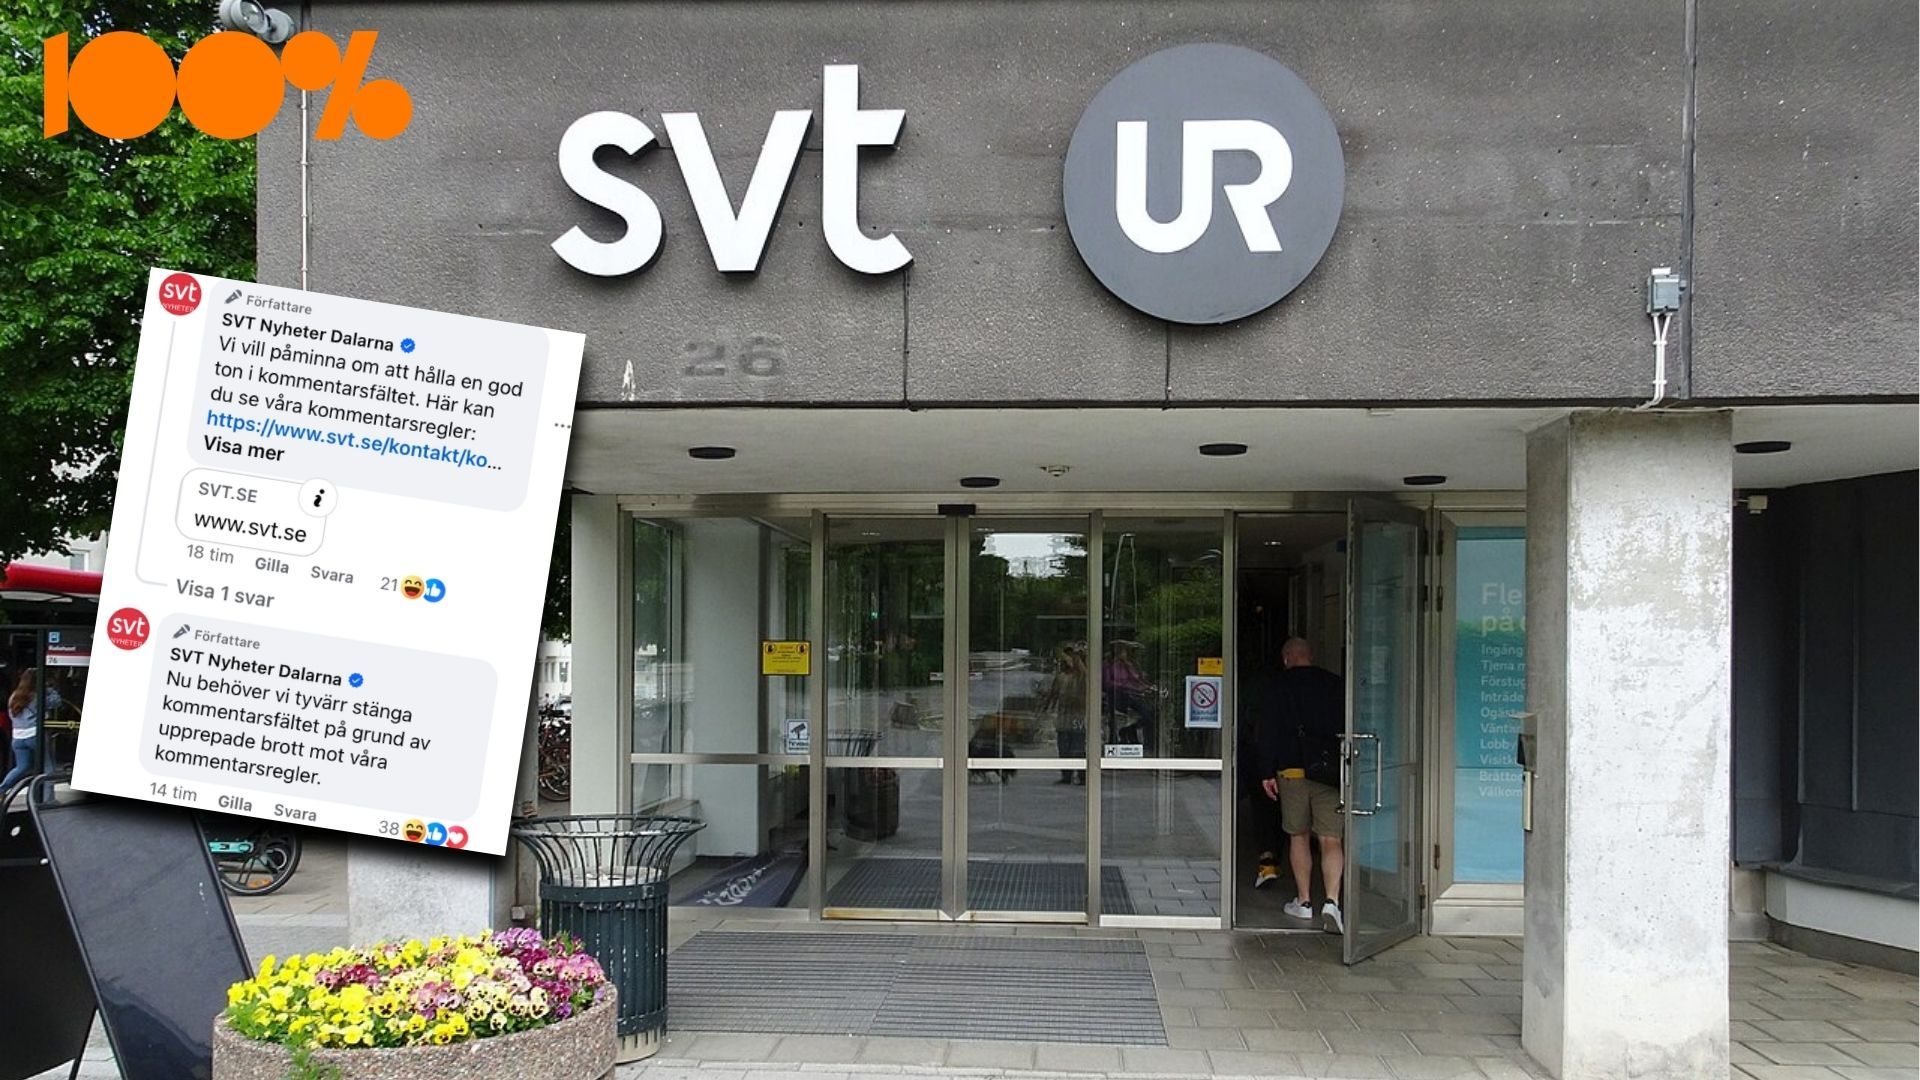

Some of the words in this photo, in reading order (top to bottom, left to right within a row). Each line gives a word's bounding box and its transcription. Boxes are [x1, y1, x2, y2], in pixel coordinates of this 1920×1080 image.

[551, 64, 913, 276] svt
[1116, 120, 1293, 253] UR
[1481, 607, 1515, 637] på
[1481, 644, 1523, 658] Ingång
[1480, 660, 1514, 673] Tjena
[1481, 690, 1524, 703] Inträde
